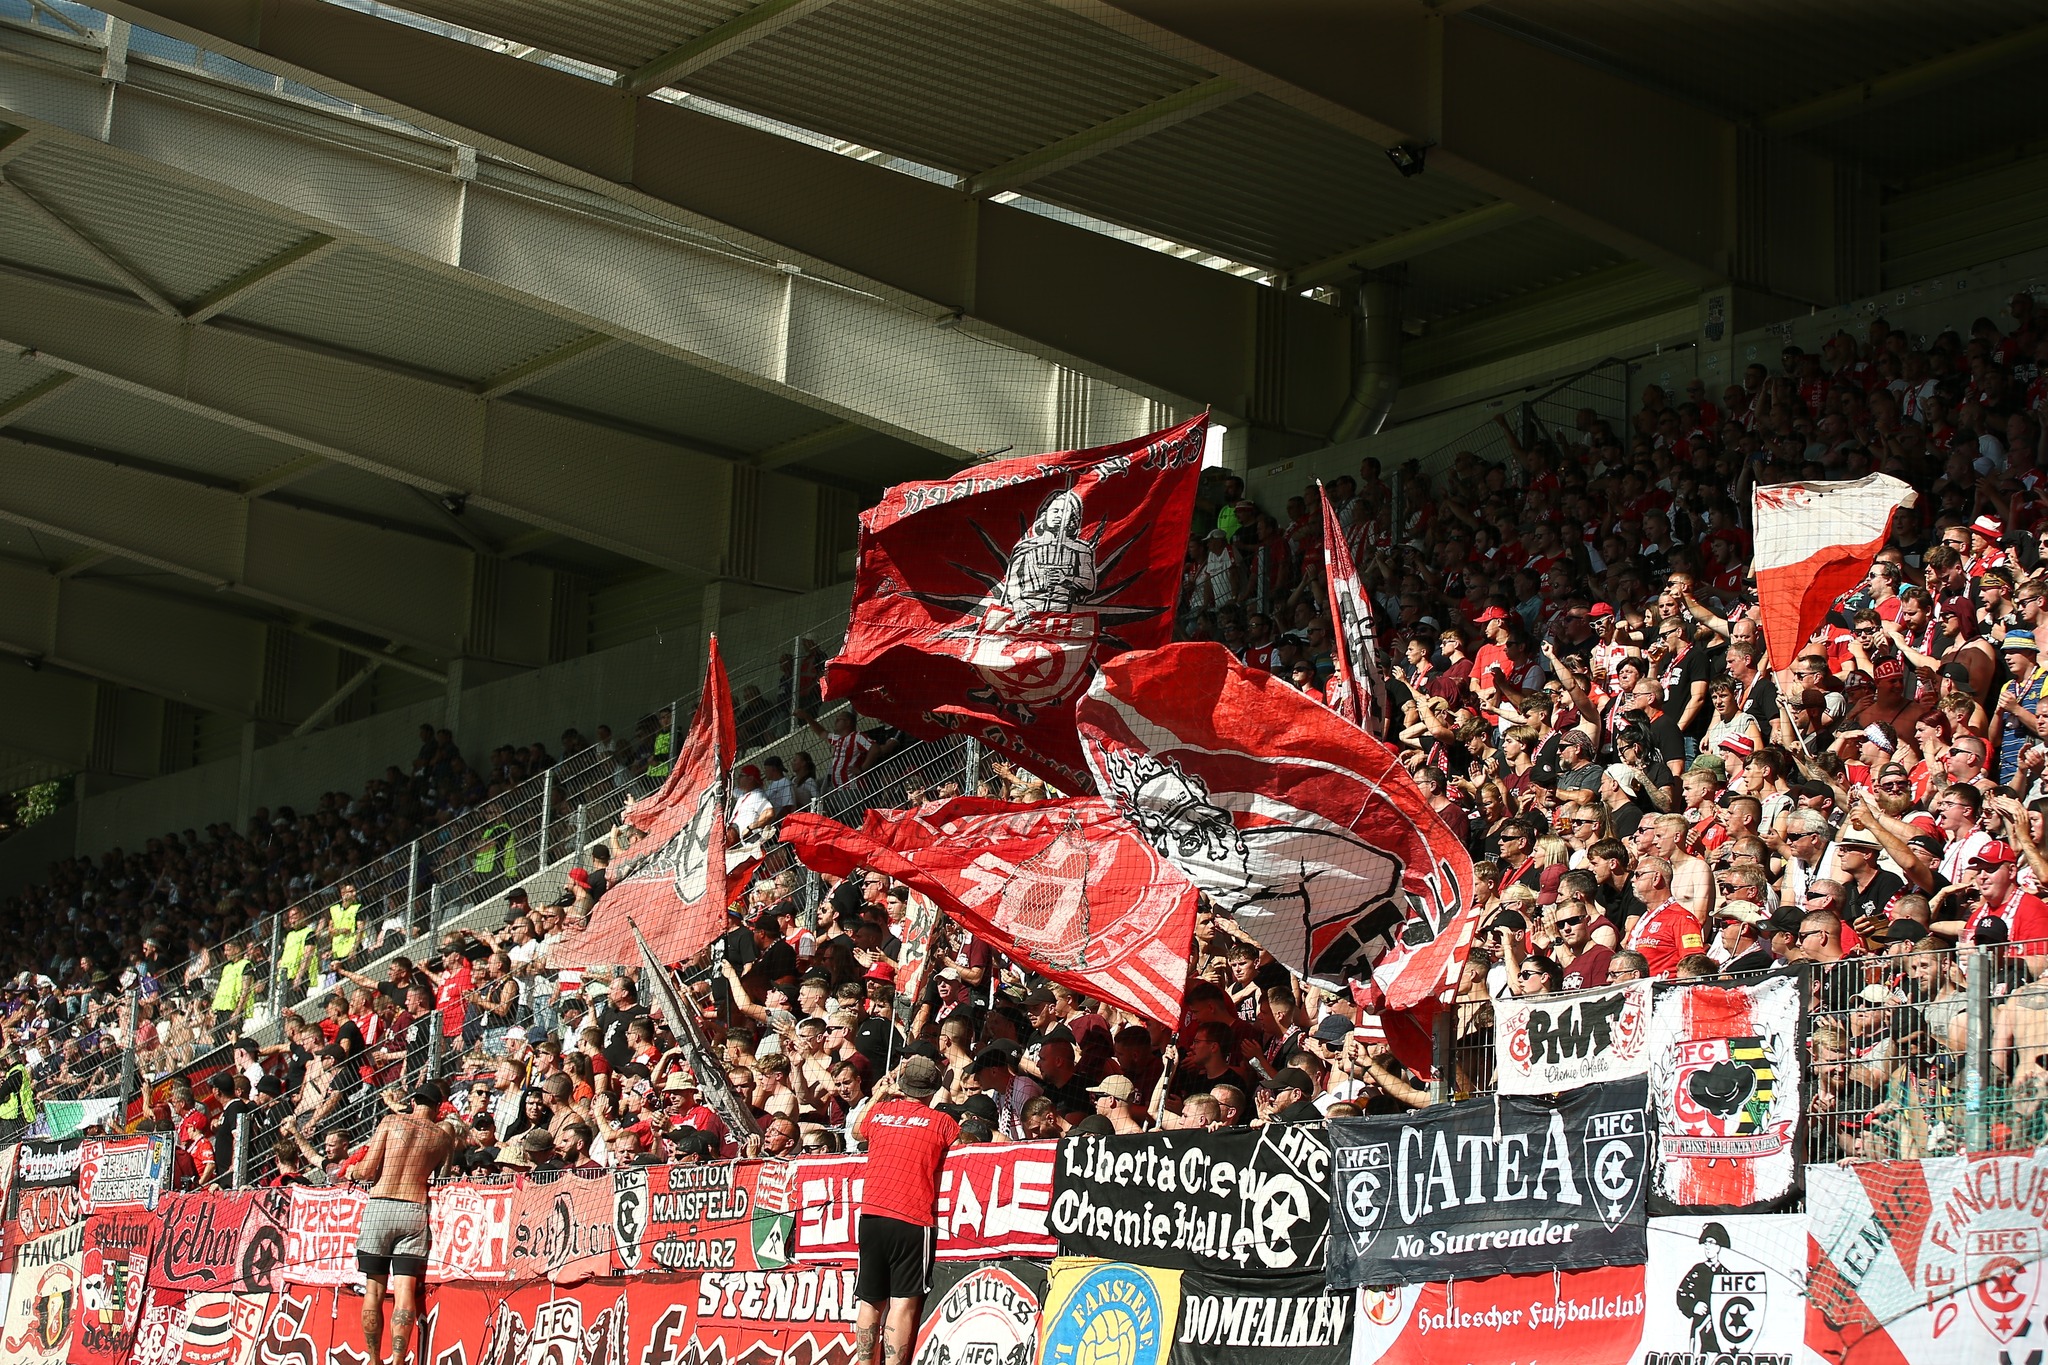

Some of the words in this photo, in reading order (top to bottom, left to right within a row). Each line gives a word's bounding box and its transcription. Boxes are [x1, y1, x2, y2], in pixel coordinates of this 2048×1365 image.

[1594, 1112, 1635, 1137] HFC
[1278, 1126, 1329, 1184] HFC
[1345, 1146, 1382, 1168] HFC
[614, 1170, 639, 1187] HFC
[668, 1164, 732, 1191] SEKTION
[455, 1197, 478, 1212] HFC
[651, 1190, 749, 1224] MANSFELD
[1931, 1160, 2048, 1255] FANCLUB
[1051, 1189, 1171, 1250] Chemie
[1173, 1200, 1254, 1263] Halle
[1391, 1235, 1425, 1260] No
[1429, 1219, 1580, 1256] Surrender
[1977, 1231, 2028, 1252] HFC
[651, 1233, 738, 1270] SÜDHARZ
[942, 1277, 1037, 1325] Ultras
[1721, 1275, 1756, 1292] HFC
[1071, 1279, 1154, 1350] FANSZENE
[1179, 1295, 1350, 1347] DOMFALKEN
